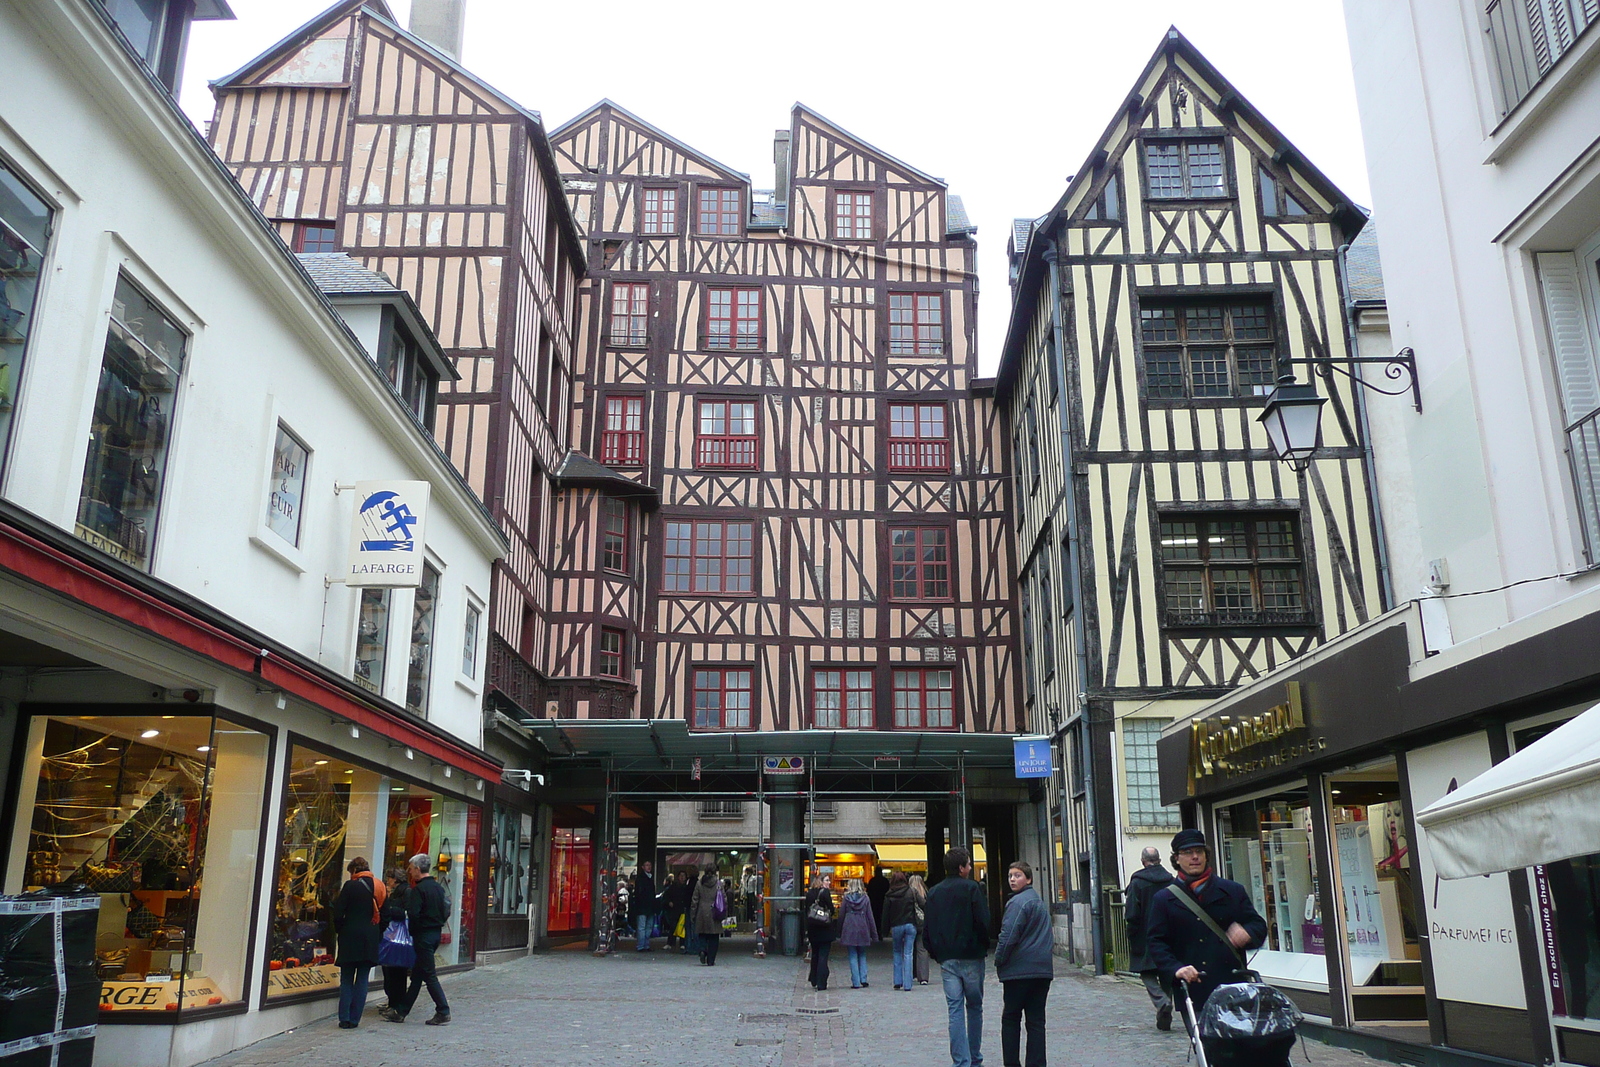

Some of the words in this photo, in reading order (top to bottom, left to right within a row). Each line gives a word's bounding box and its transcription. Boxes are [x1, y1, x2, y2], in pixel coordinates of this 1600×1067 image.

[277, 454, 296, 478] ART
[280, 478, 288, 494] &
[271, 491, 293, 520] CUIR
[81, 528, 138, 566] AFARGE
[351, 563, 415, 574] LAFARGE
[1030, 759, 1047, 767] JOUR
[1536, 865, 1544, 875] M
[1539, 877, 1548, 905] chez
[12, 903, 32, 911] FRAGILE
[1542, 907, 1557, 969] exclusivité
[273, 969, 331, 990] LAFARGE
[1552, 972, 1560, 988] En
[100, 986, 163, 1005] RGE
